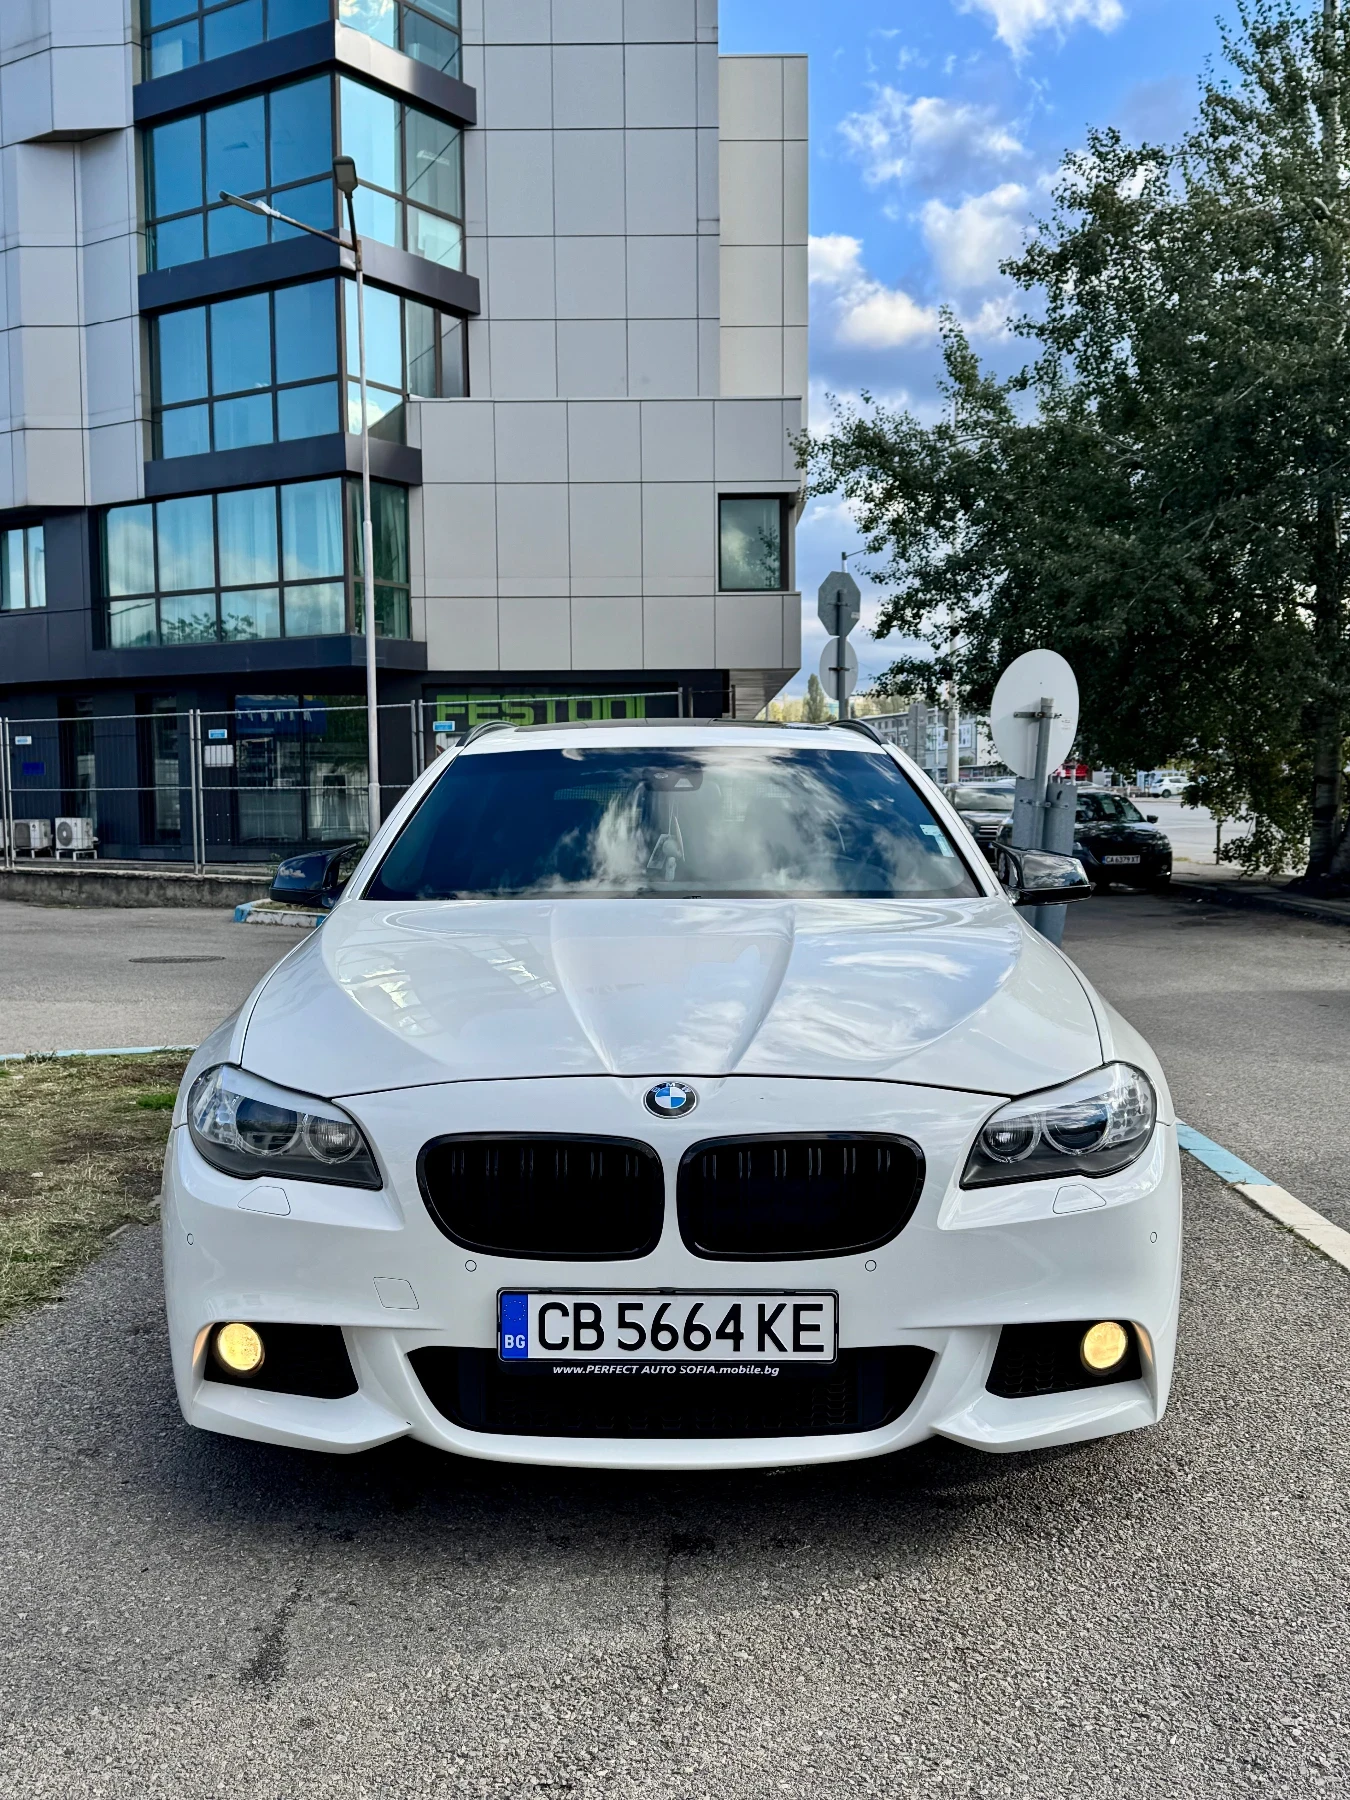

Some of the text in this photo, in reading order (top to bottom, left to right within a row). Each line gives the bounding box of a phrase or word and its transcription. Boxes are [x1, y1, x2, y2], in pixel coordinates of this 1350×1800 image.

[650, 1082, 692, 1093] BMW
[538, 1301, 824, 1352] CB 5664 KE
[504, 1334, 526, 1349] BG
[553, 1365, 780, 1377] www.PERFECT AUTO SOFIA.mobile.bg
